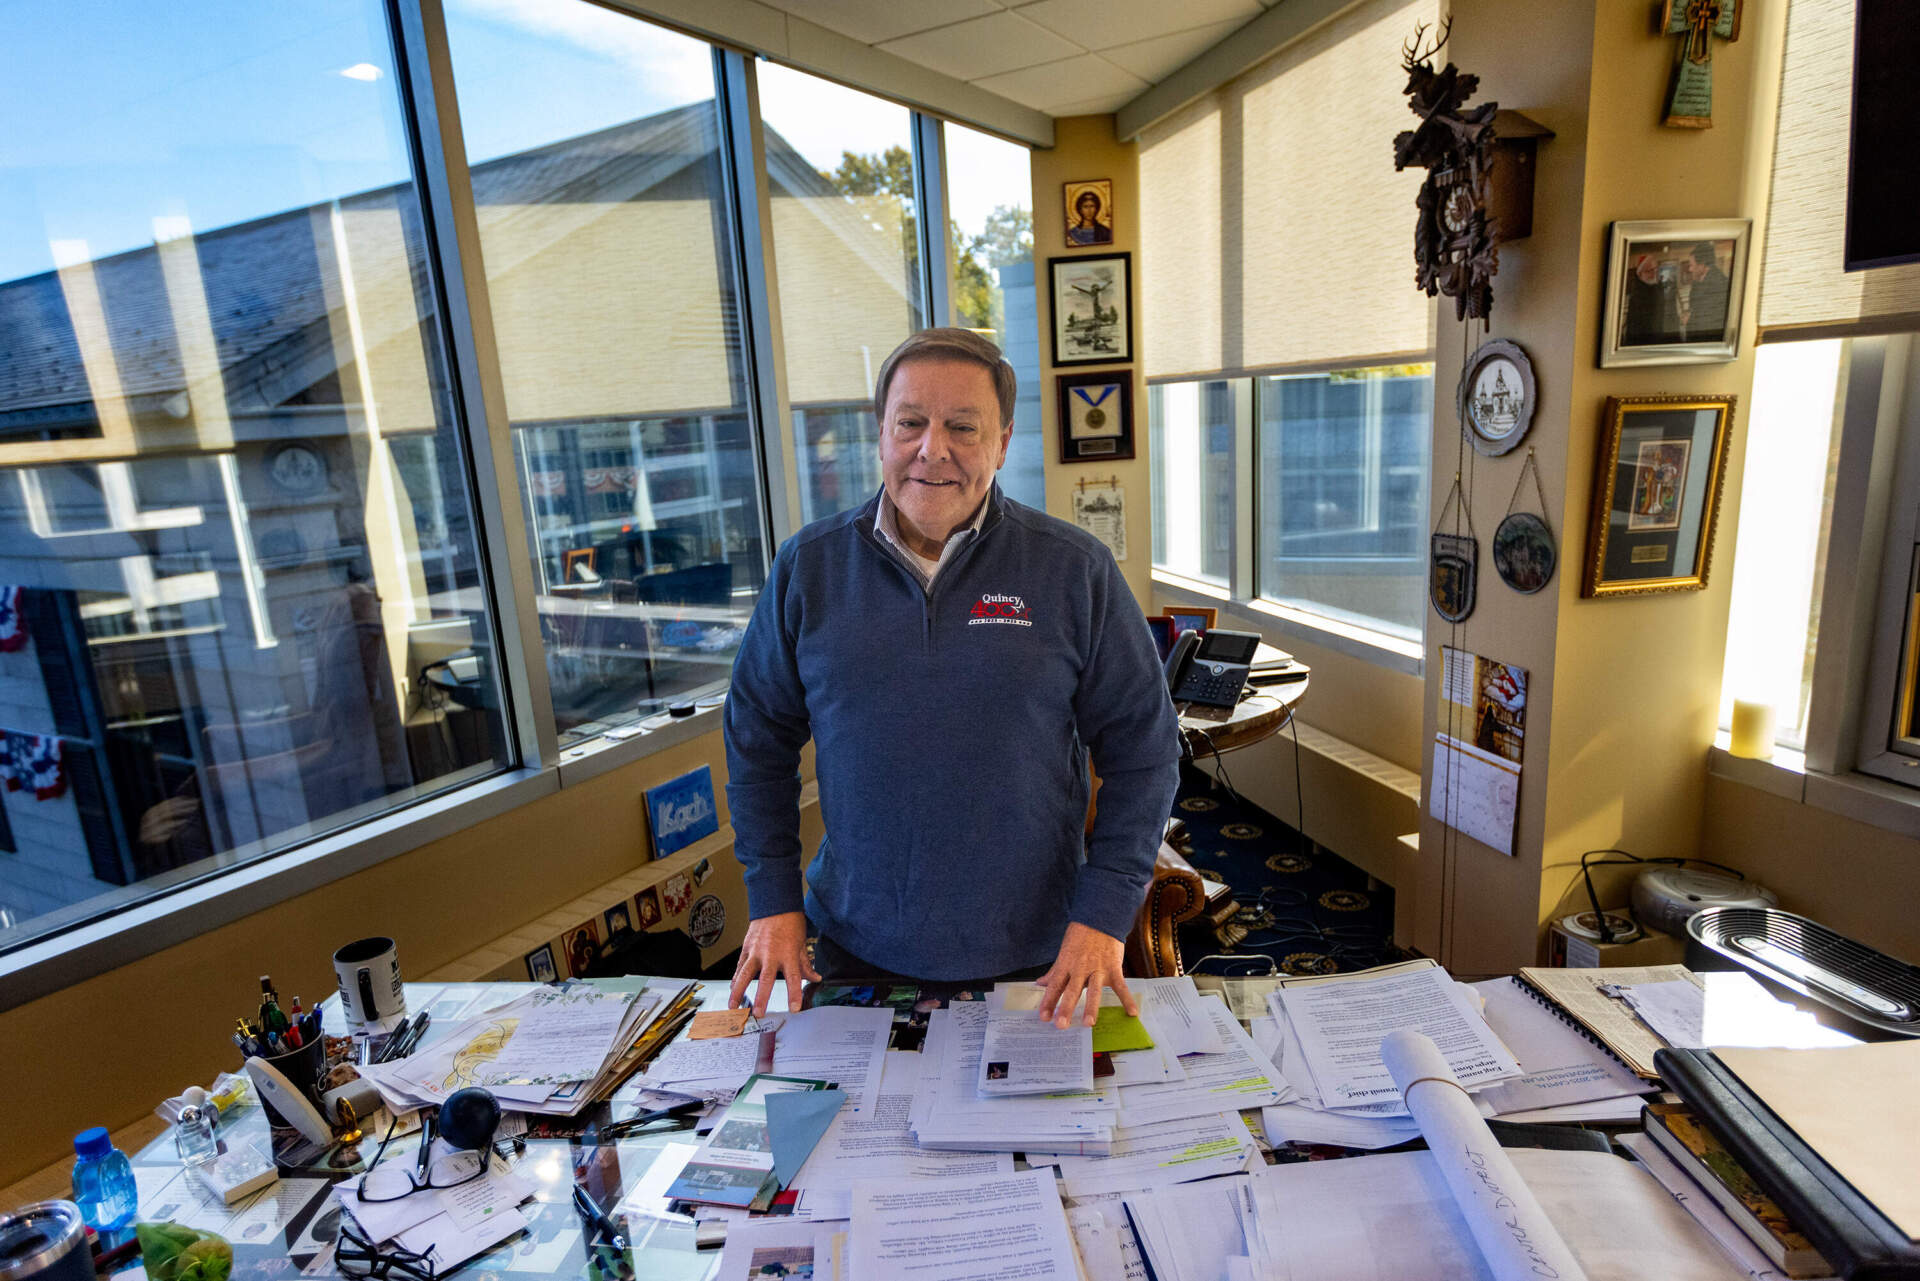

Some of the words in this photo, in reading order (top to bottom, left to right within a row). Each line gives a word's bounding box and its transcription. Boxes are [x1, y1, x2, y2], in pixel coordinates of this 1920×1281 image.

[982, 593, 1021, 605] Quincy
[970, 600, 1017, 618] 400
[700, 903, 721, 917] GOD
[1474, 1060, 1497, 1069] steps
[1347, 1090, 1369, 1099] chief
[1369, 1087, 1400, 1095] transit
